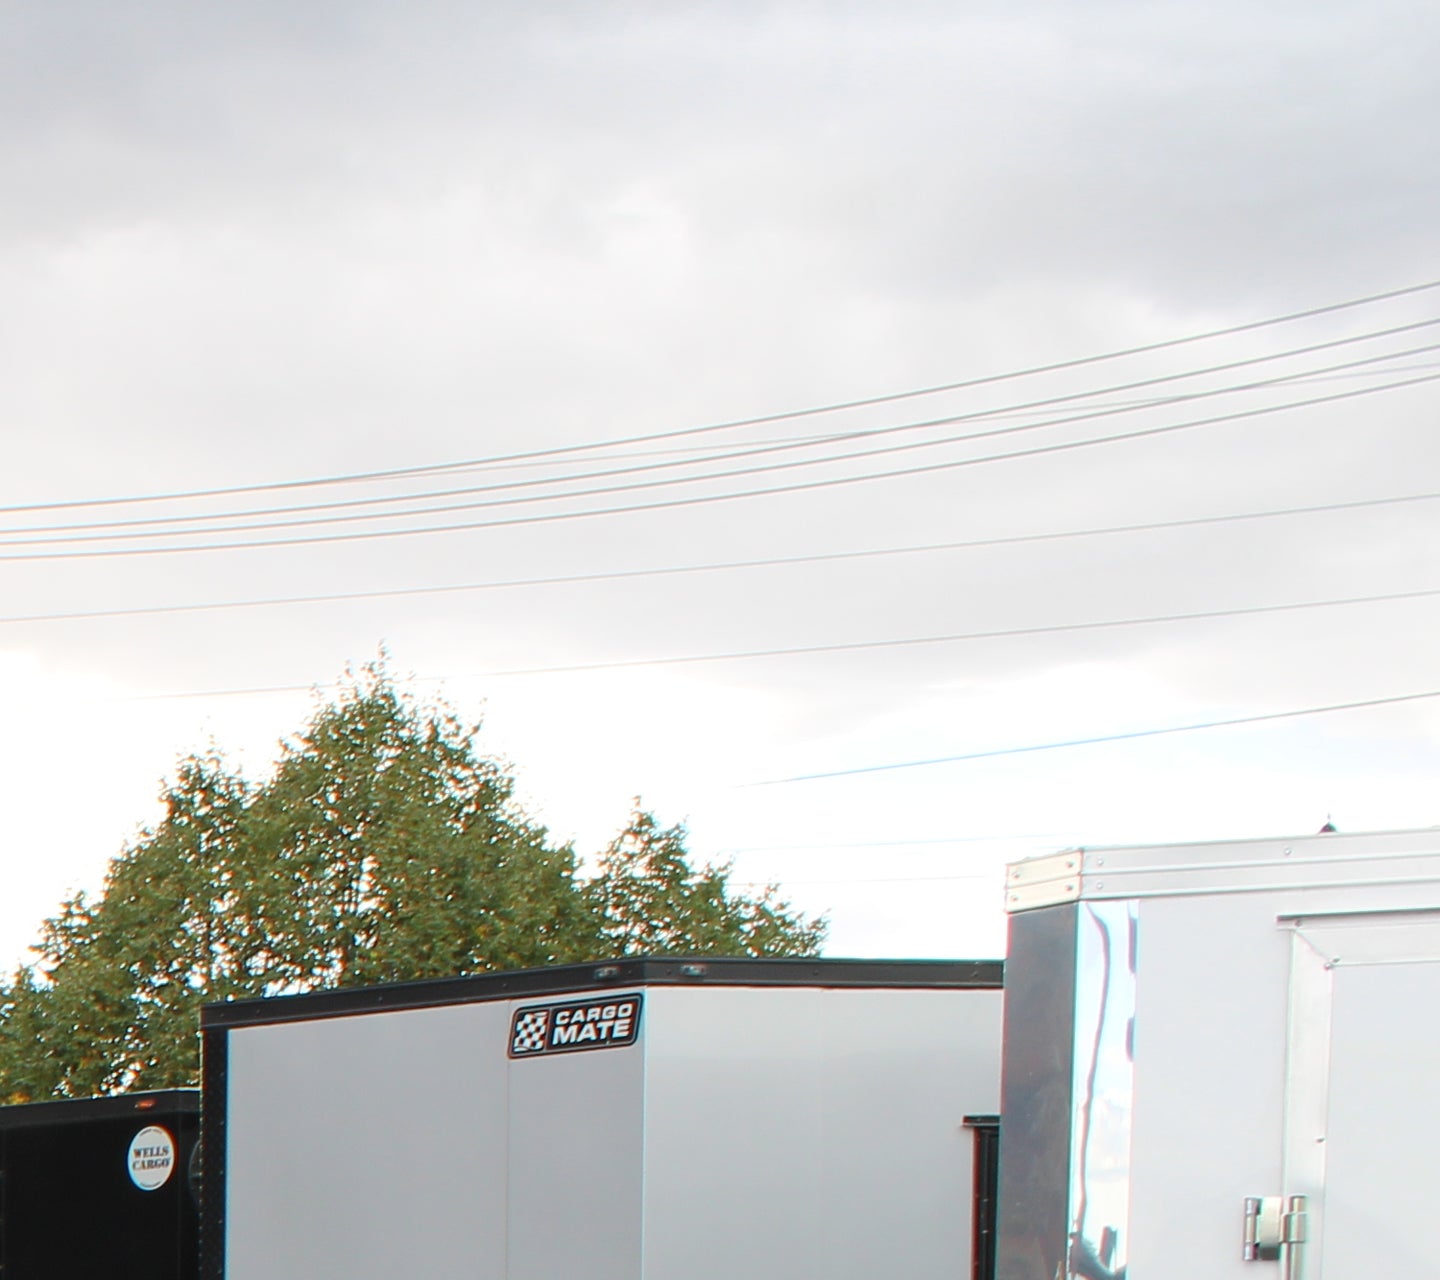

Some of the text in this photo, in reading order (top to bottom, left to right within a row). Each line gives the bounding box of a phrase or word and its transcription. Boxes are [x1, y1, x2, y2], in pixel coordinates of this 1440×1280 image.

[556, 1003, 633, 1025] CARGO
[552, 1018, 631, 1045] MATE
[134, 1146, 169, 1158] WELLS
[133, 1158, 170, 1170] CARGO
